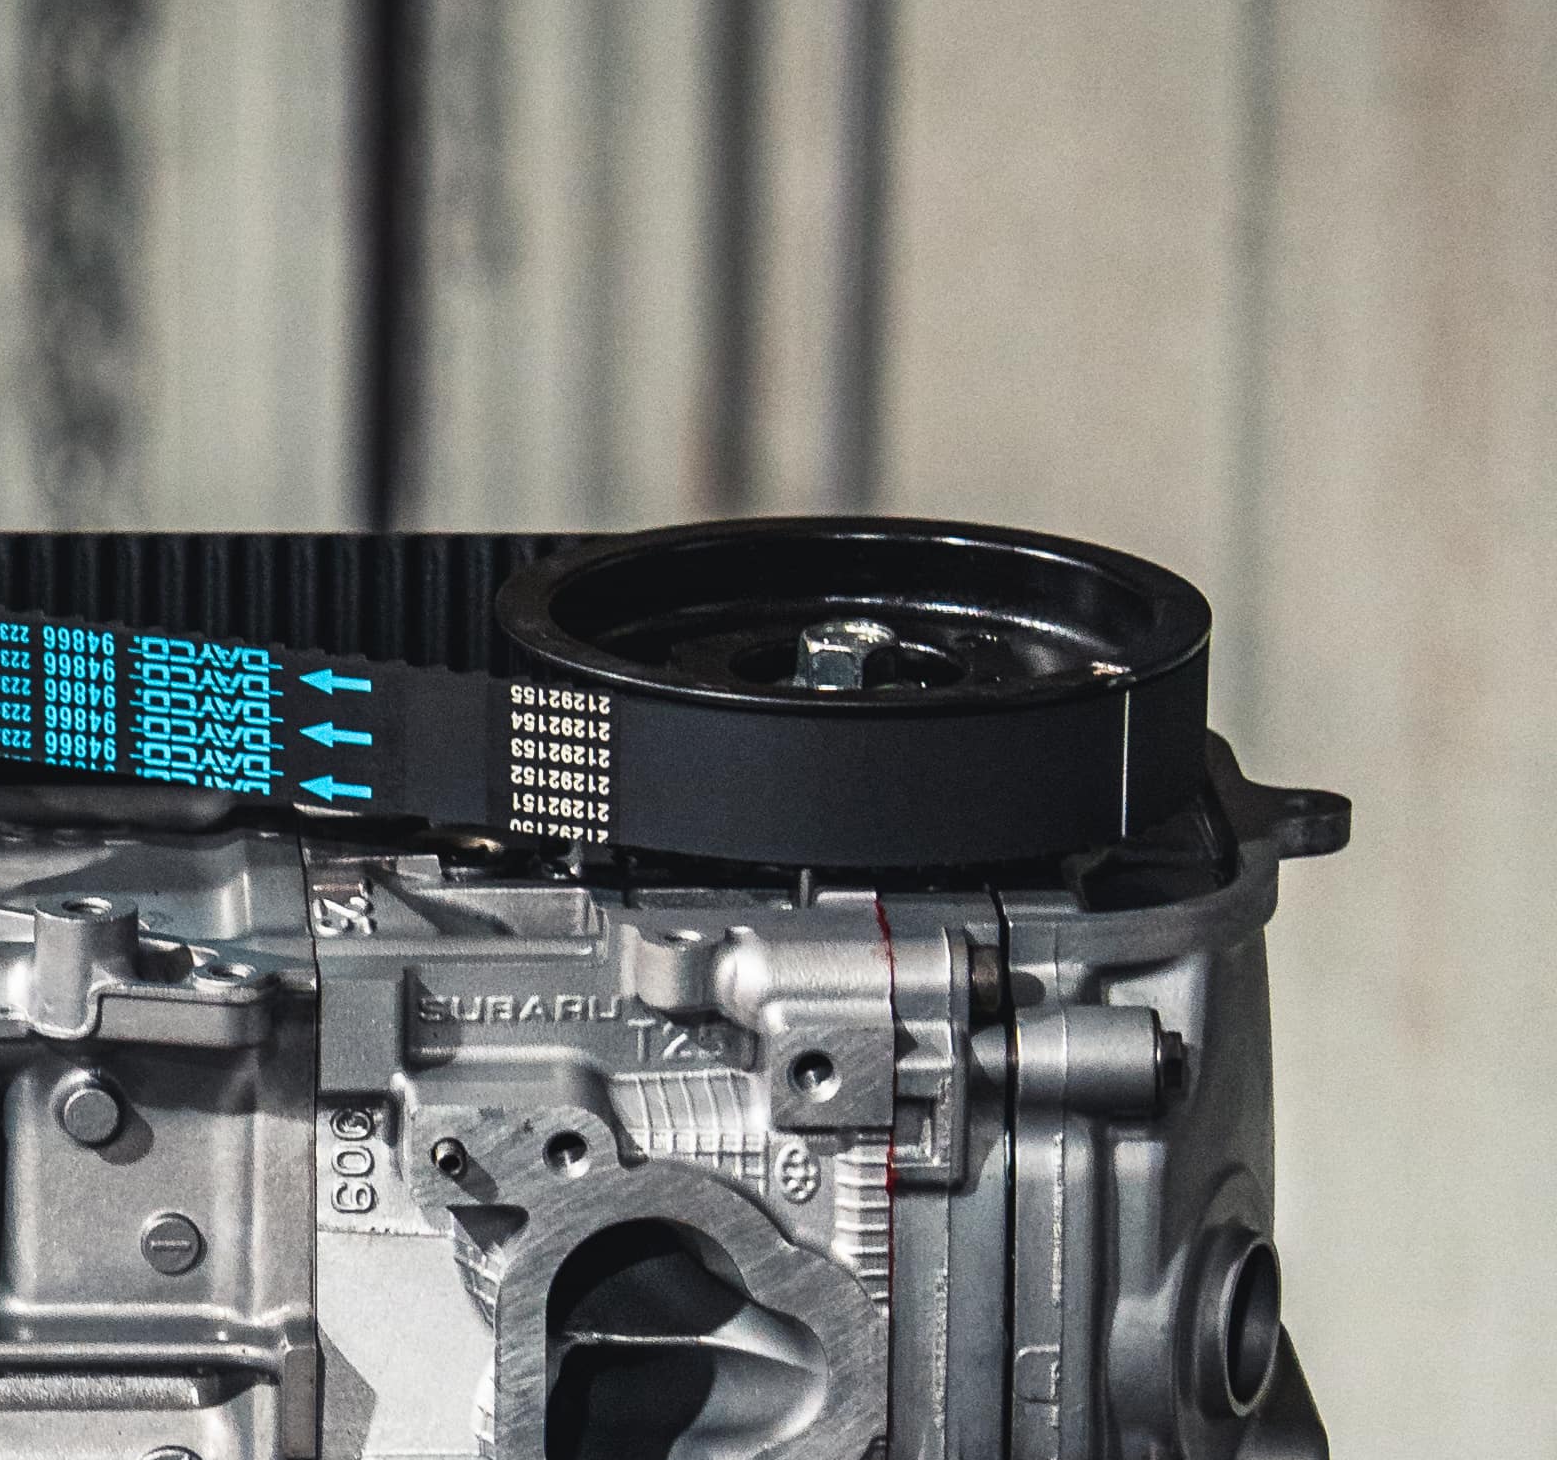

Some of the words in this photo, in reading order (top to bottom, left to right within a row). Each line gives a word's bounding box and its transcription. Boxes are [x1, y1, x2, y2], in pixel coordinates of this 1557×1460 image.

[43, 625, 114, 656] 94866
[44, 651, 116, 682] 94866
[44, 678, 116, 708] 94866
[510, 685, 611, 714] 21292155
[45, 704, 116, 735] 94866
[511, 711, 611, 741] 21292154
[45, 731, 117, 761] 94866
[510, 738, 611, 768] 21292153
[510, 764, 611, 795] 21292152
[512, 792, 610, 822] 21292151
[417, 993, 623, 1025] SUBARU
